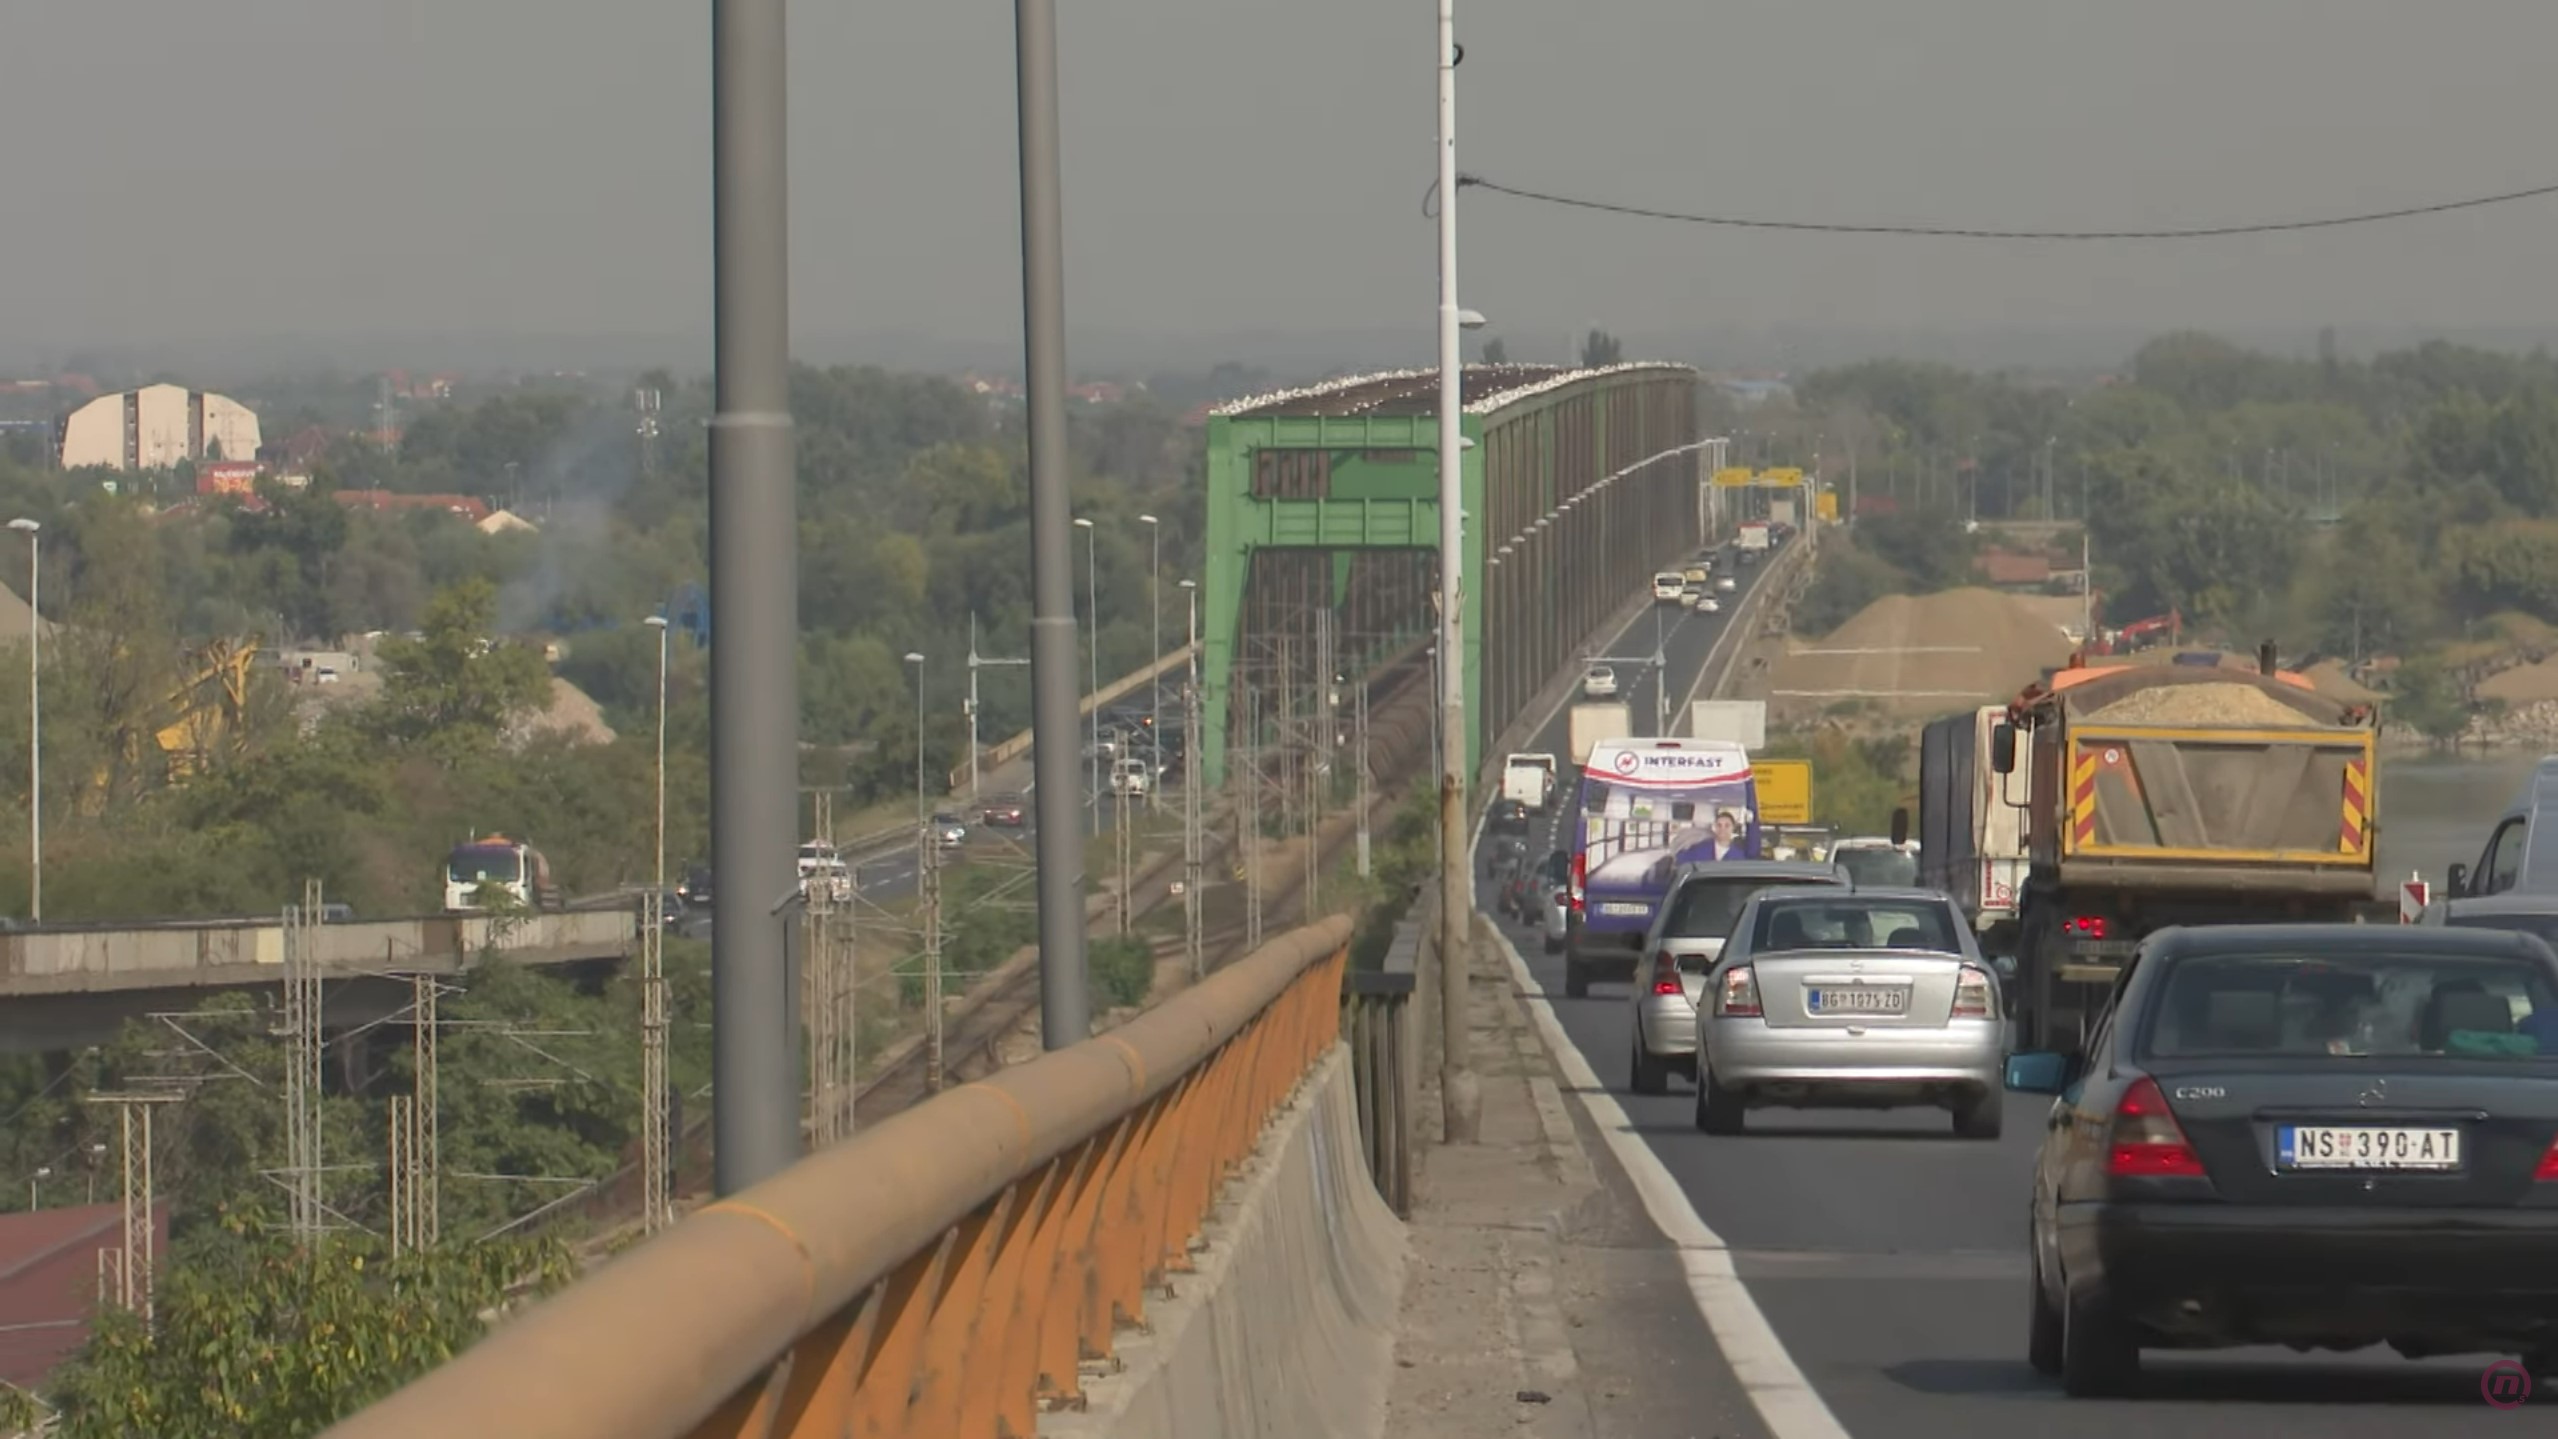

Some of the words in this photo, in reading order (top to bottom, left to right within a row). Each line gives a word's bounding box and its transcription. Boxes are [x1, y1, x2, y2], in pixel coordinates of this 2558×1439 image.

[1644, 756, 1723, 768] INTERFAST
[1822, 993, 1838, 1008] BG
[2176, 1087, 2225, 1099] C200
[2301, 1130, 2334, 1157] NS
